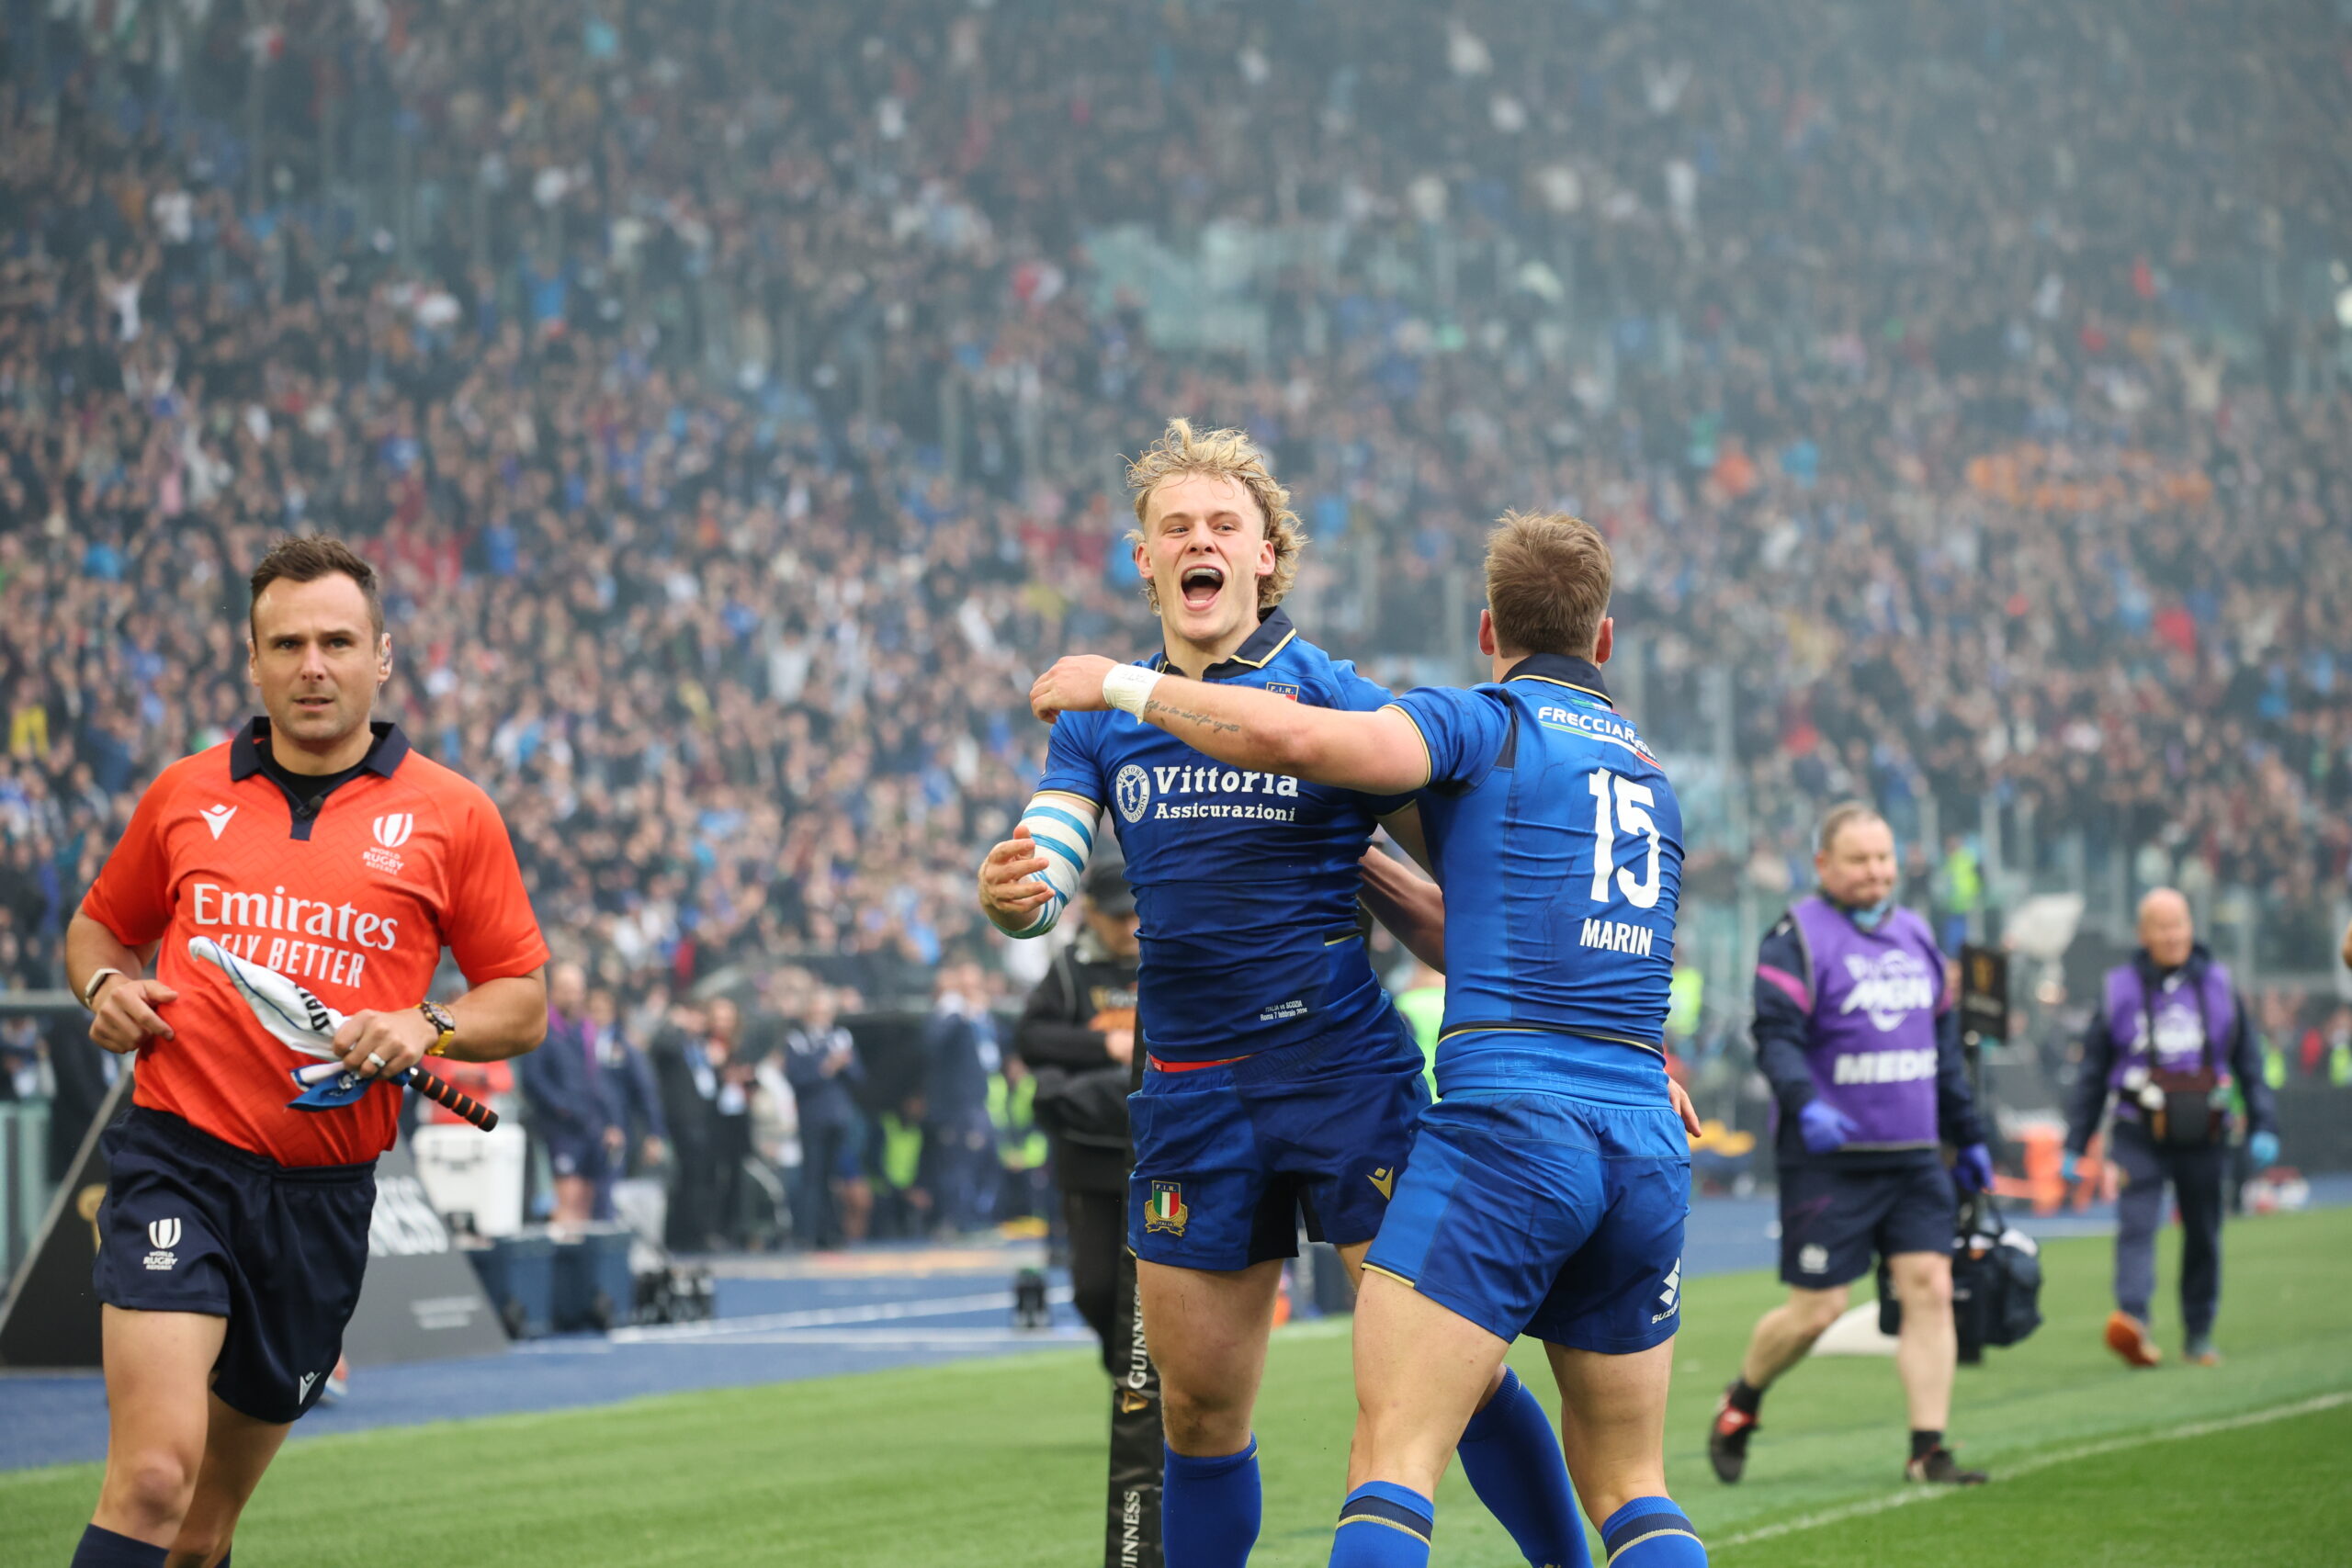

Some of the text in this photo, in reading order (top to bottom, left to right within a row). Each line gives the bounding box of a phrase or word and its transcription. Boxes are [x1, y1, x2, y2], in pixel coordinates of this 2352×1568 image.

[1153, 765, 1298, 797] Vittoria
[1154, 802, 1295, 821] Assicurazioni
[1589, 766, 1661, 908] 15
[363, 851, 404, 870] RUGBY
[193, 883, 399, 951] Emirates
[1579, 917, 1653, 957] MARIN
[266, 937, 366, 988] BETTER
[1286, 1000, 1302, 1009] SCOZIA
[143, 1256, 178, 1265] RUGBY
